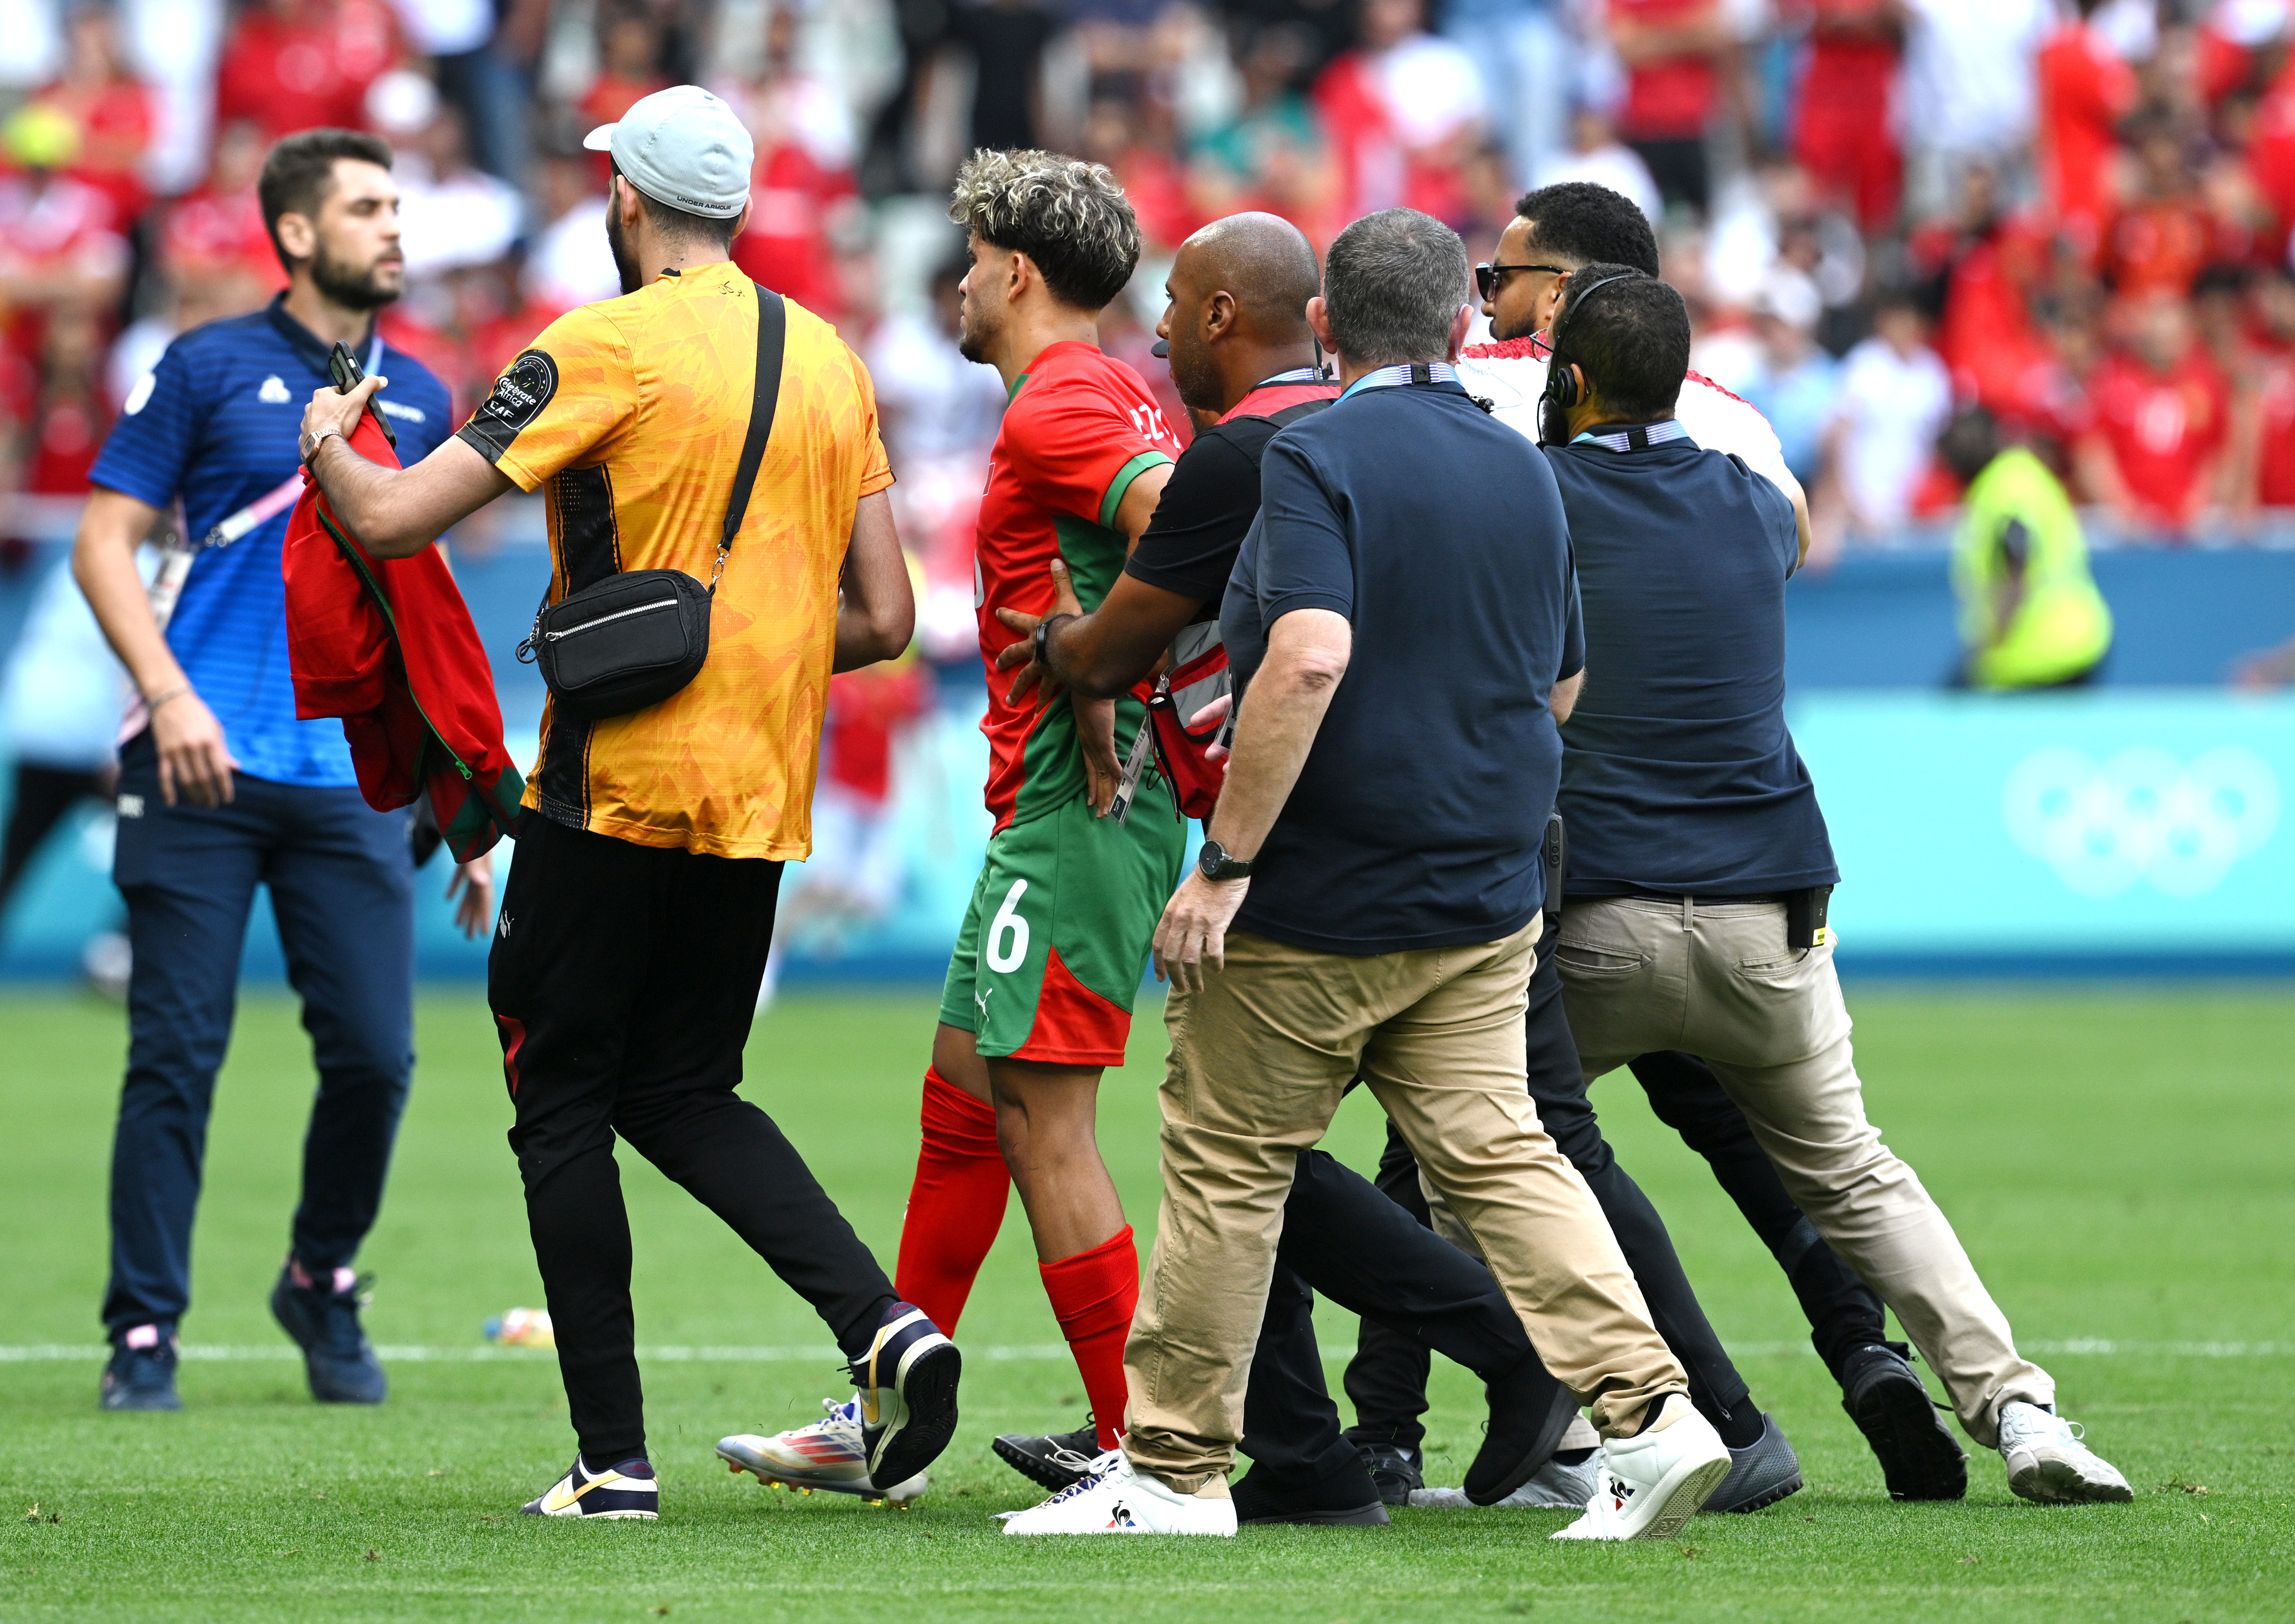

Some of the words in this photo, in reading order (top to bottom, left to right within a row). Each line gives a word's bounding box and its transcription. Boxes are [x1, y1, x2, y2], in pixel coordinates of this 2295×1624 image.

[677, 195, 704, 208] UNDER
[497, 388, 523, 407] Africa
[499, 377, 536, 405] Celebrate
[490, 401, 514, 418] CAF
[987, 879, 1029, 973] 6
